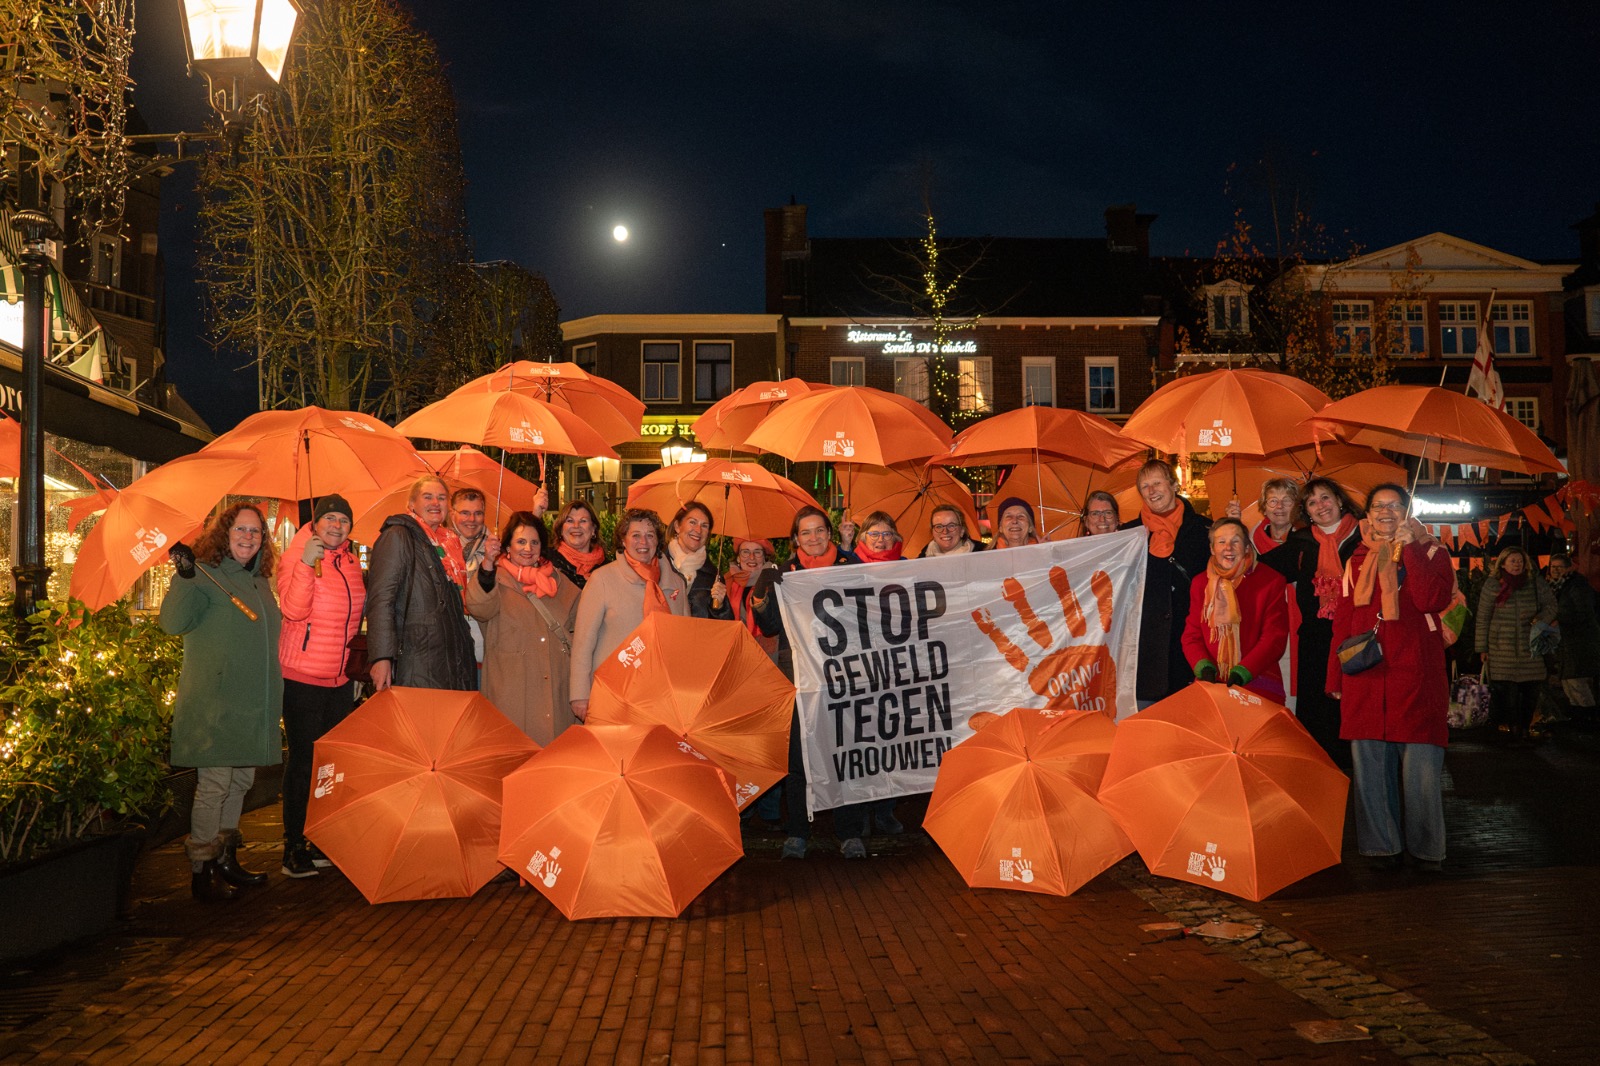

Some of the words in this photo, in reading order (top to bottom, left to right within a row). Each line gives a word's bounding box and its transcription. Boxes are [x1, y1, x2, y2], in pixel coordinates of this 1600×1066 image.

[847, 330, 896, 343] Ristorante
[882, 342, 915, 354] Sorella
[812, 581, 947, 657] STOP
[823, 640, 949, 699] GEWELD
[827, 682, 953, 748] TEGEN
[832, 736, 953, 783] VROUWEN
